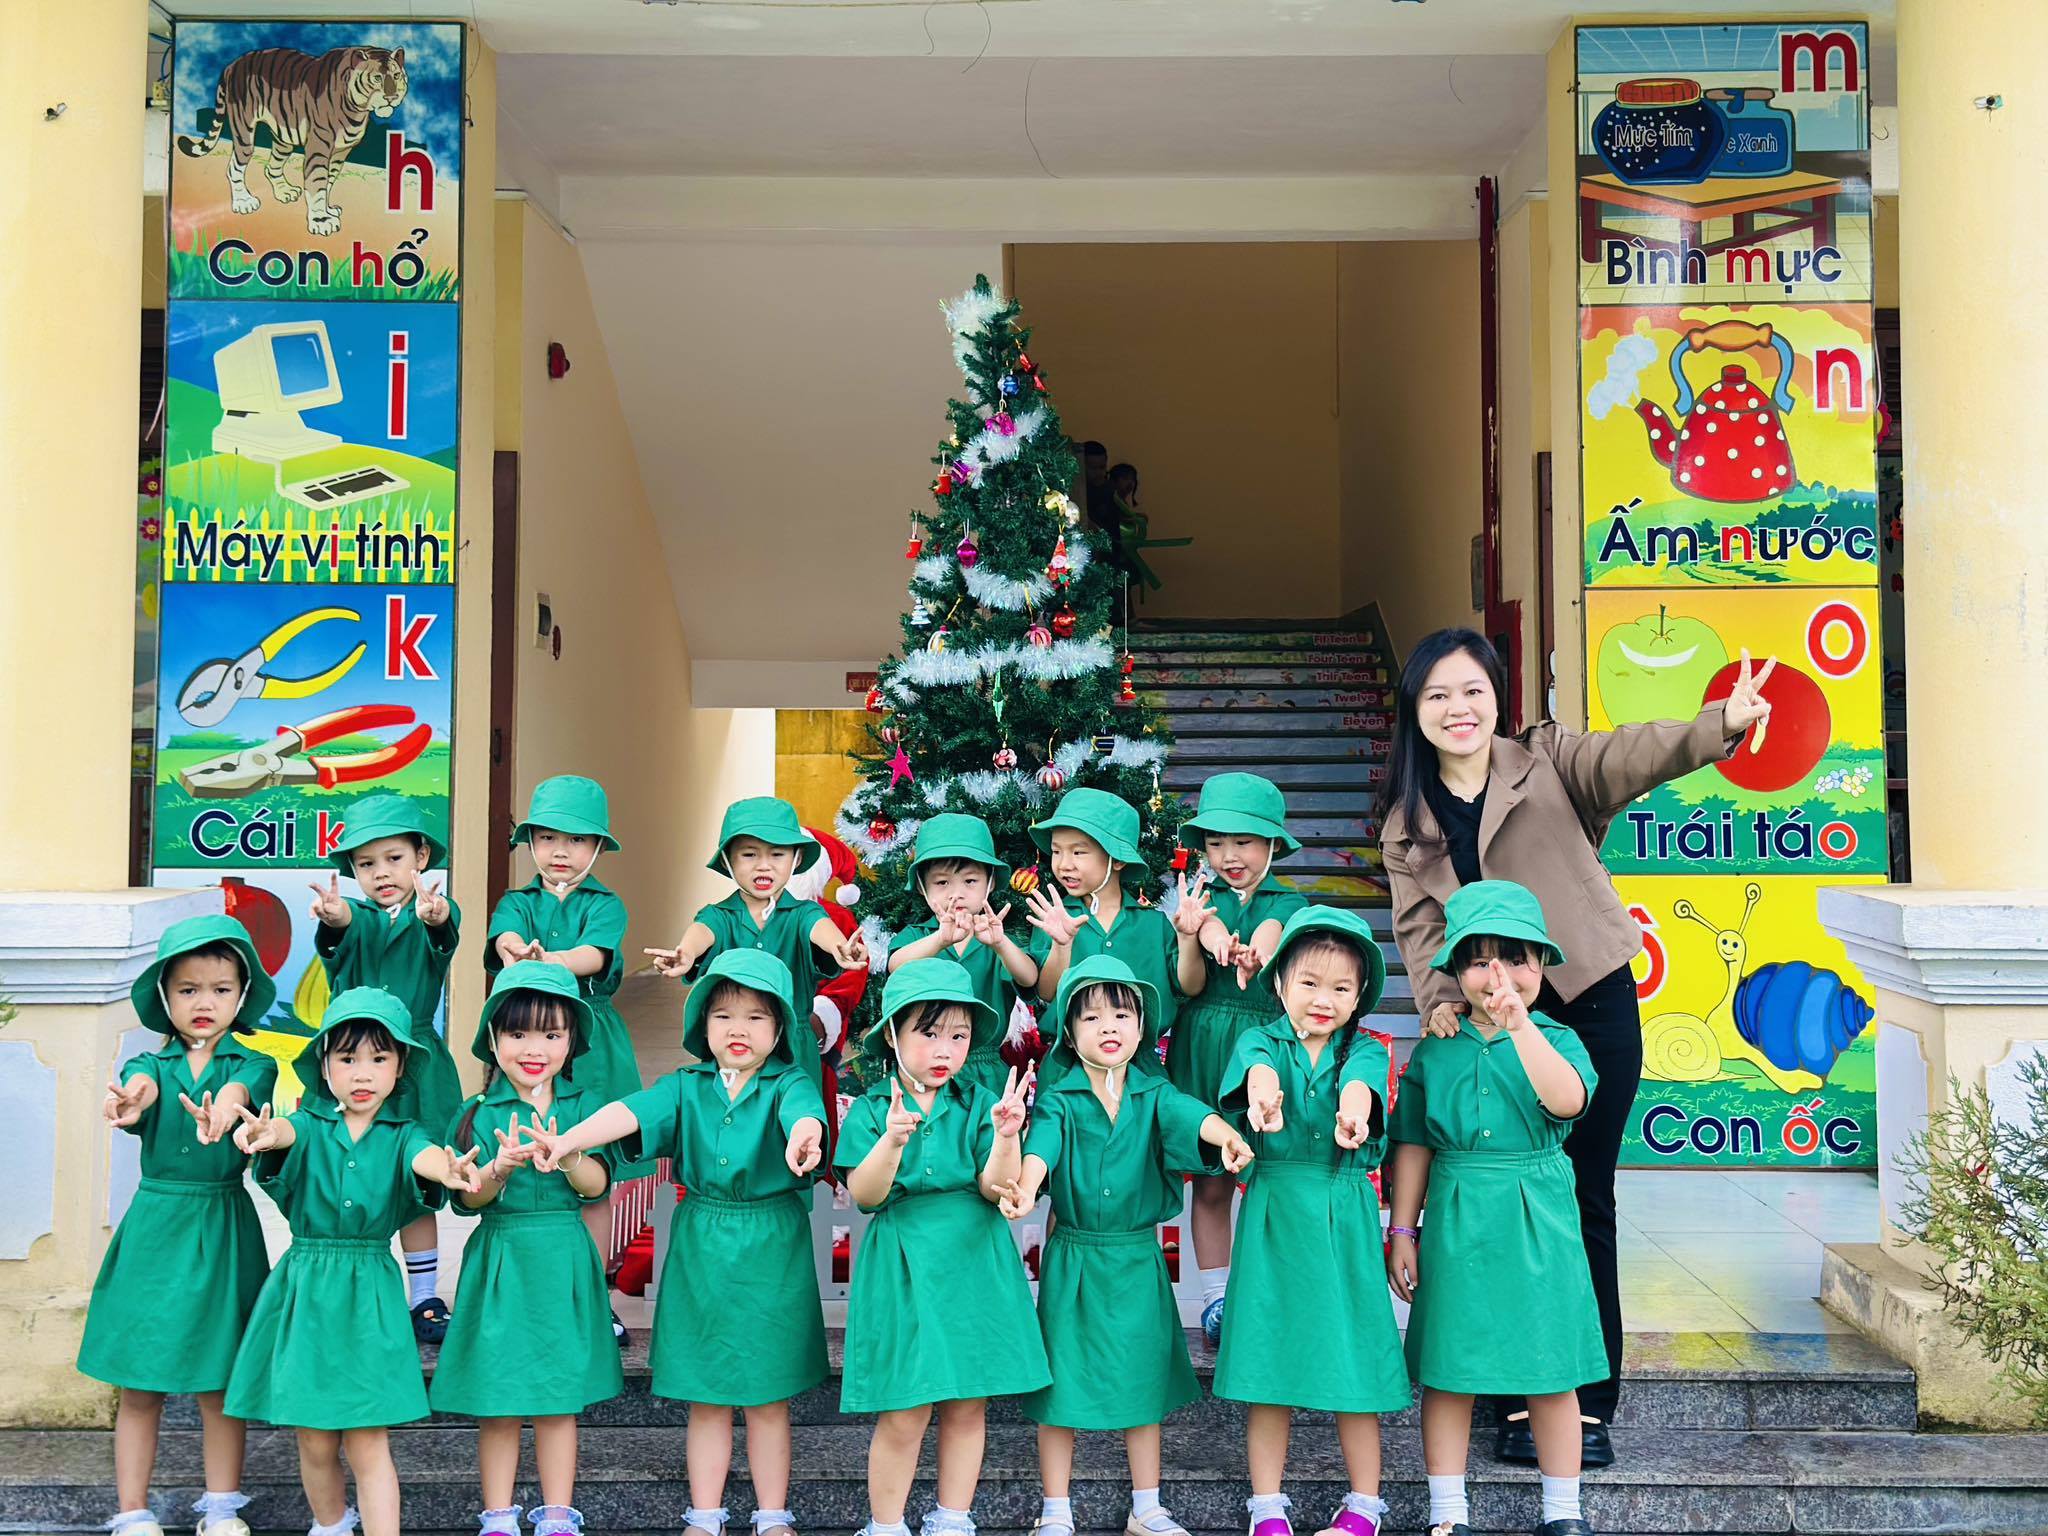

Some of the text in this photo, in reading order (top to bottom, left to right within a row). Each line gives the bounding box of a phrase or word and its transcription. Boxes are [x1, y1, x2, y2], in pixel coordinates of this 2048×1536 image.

[1778, 29, 1861, 95] m
[1614, 123, 1658, 153] Mực
[1661, 122, 1694, 147] Tím
[1738, 132, 1778, 153] Xanh
[386, 130, 437, 215] h
[208, 227, 430, 288] Con hổ
[1606, 237, 1843, 295] Bình mực
[387, 330, 409, 440] i
[1813, 344, 1867, 413] n
[175, 519, 441, 582] Máy vi tính
[1597, 497, 1875, 564] Ấm nước
[384, 594, 440, 681] k
[1333, 692, 1377, 703] Twelve
[1342, 715, 1384, 726] Eleven
[189, 808, 296, 859] Cái
[1626, 807, 1859, 860] Trái táo
[1642, 1097, 1861, 1157] Con ốc
